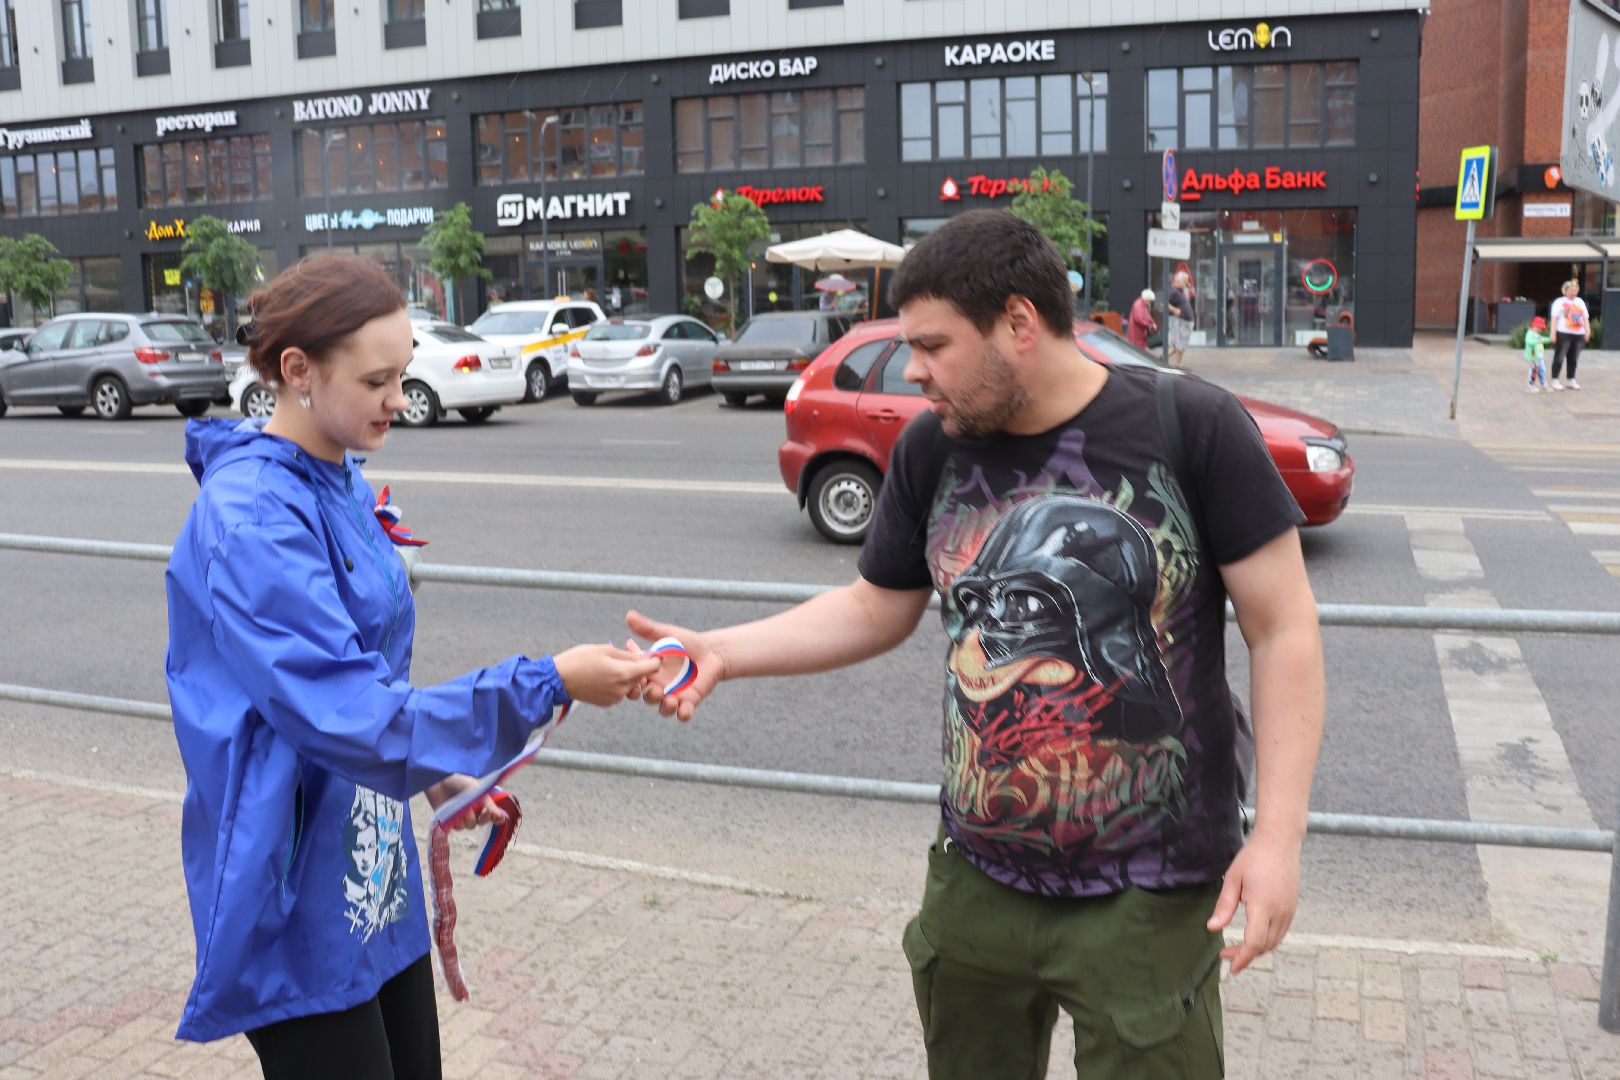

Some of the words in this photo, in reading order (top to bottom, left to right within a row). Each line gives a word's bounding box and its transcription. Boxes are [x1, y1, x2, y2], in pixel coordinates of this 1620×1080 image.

[944, 39, 1055, 66] КАРАОКЕ
[709, 60, 776, 85] ДИСКО
[779, 56, 818, 78] БАР
[292, 94, 363, 121] BATONO
[368, 88, 432, 115] JONNY
[155, 110, 238, 137] ресторан
[1181, 167, 1261, 198] Альфа
[1265, 166, 1328, 189] Банк
[386, 206, 434, 227] ПОДАРКИ
[526, 191, 631, 220] МАГНИТ
